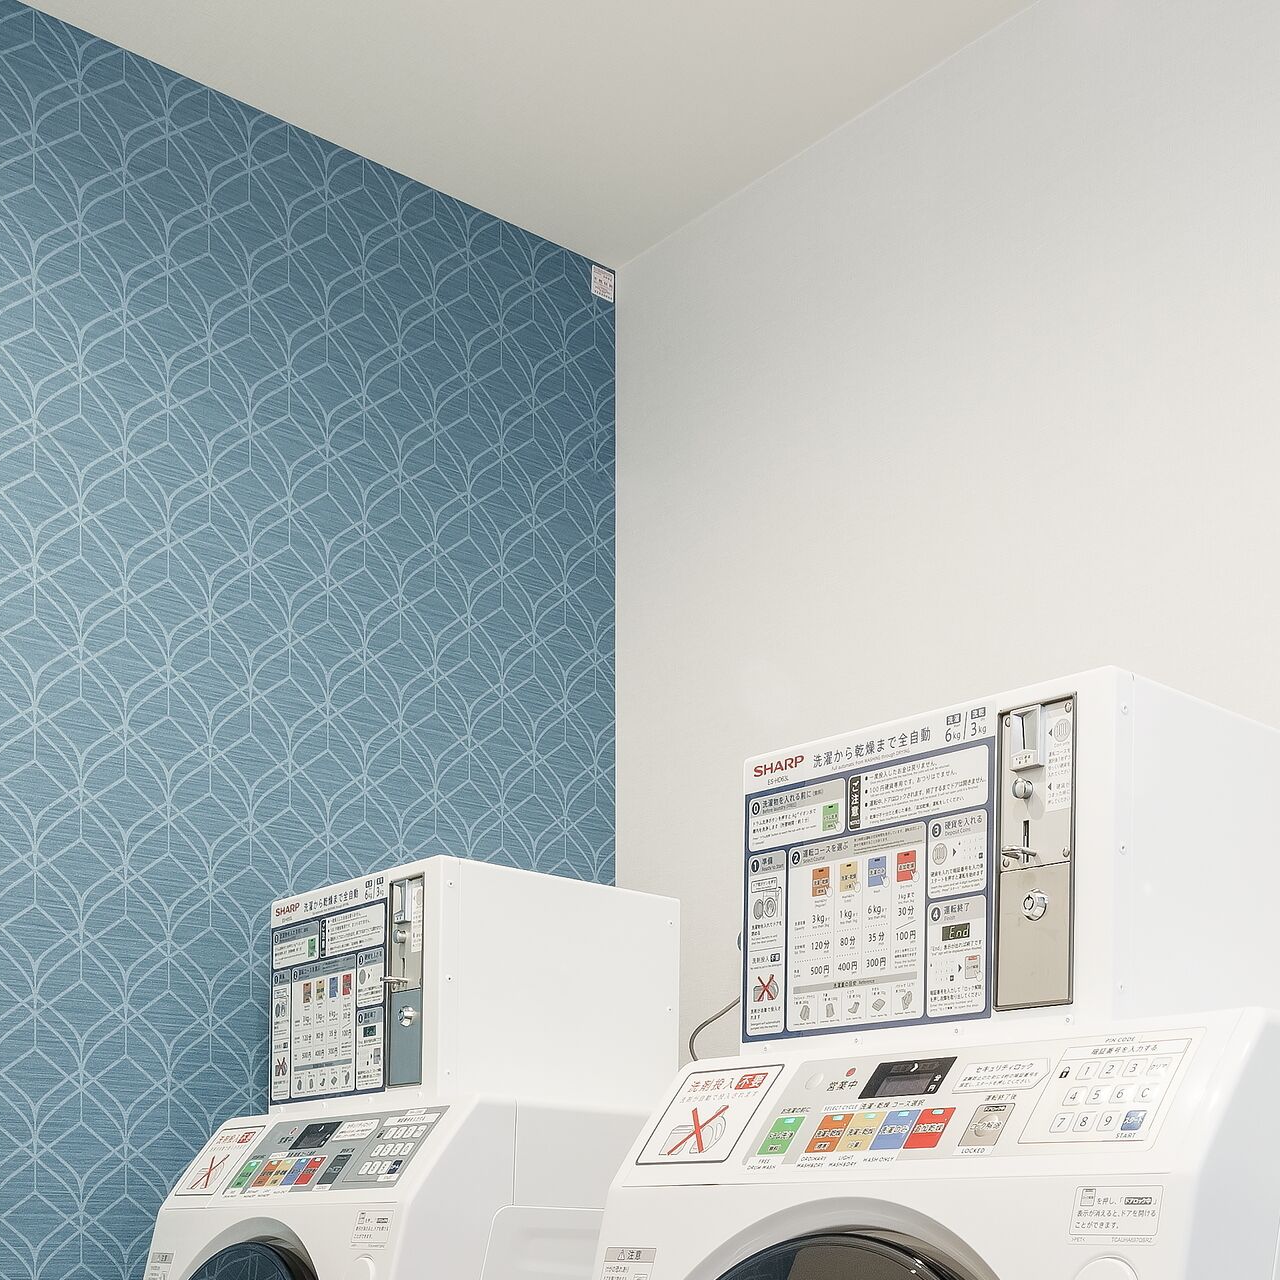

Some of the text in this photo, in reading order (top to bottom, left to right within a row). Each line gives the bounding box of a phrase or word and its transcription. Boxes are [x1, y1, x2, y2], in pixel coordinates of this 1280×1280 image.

[812, 727, 931, 769] 洗濯から乾燥まで全自動
[753, 755, 805, 777] SHARP
[869, 761, 938, 780] 一度投入したお金は戻りません。
[762, 791, 812, 808] 洗濯物を入れる前に
[944, 815, 982, 830] 硬貨を入れる
[802, 842, 849, 858] 運転コースを選ぶ
[303, 888, 359, 913] 洗濯から乾燥まで全自動
[275, 902, 300, 917] SHARP
[898, 906, 914, 916] 30分
[944, 903, 970, 915] 運転終了
[949, 925, 969, 939] End
[811, 940, 830, 950] 120分
[840, 936, 856, 947] 80分
[896, 930, 916, 941] 100円
[811, 965, 830, 975] 500円
[838, 961, 858, 971] 400円
[866, 957, 887, 968] 300円
[1091, 1045, 1158, 1055] 暗証番号を入力する
[976, 1062, 1035, 1074] セキュリティロック
[1105, 1065, 1115, 1074] 2
[1129, 1063, 1138, 1073] 3
[688, 1074, 766, 1093] 洗剤投入 不要
[827, 1081, 859, 1092] 営業中
[927, 1084, 935, 1092] 円
[985, 1094, 1017, 1102] 運転終了後
[1092, 1090, 1101, 1100] 5
[1116, 1089, 1124, 1099] 6
[1141, 1088, 1150, 1098] C
[891, 1099, 926, 1108] コース選択
[1057, 1118, 1066, 1128] 7
[1080, 1116, 1088, 1127] 8
[1104, 1116, 1112, 1127] 9
[1077, 1210, 1156, 1218] 表示が消えると、ドアを開ける
[1075, 1221, 1119, 1229] ことができます。
